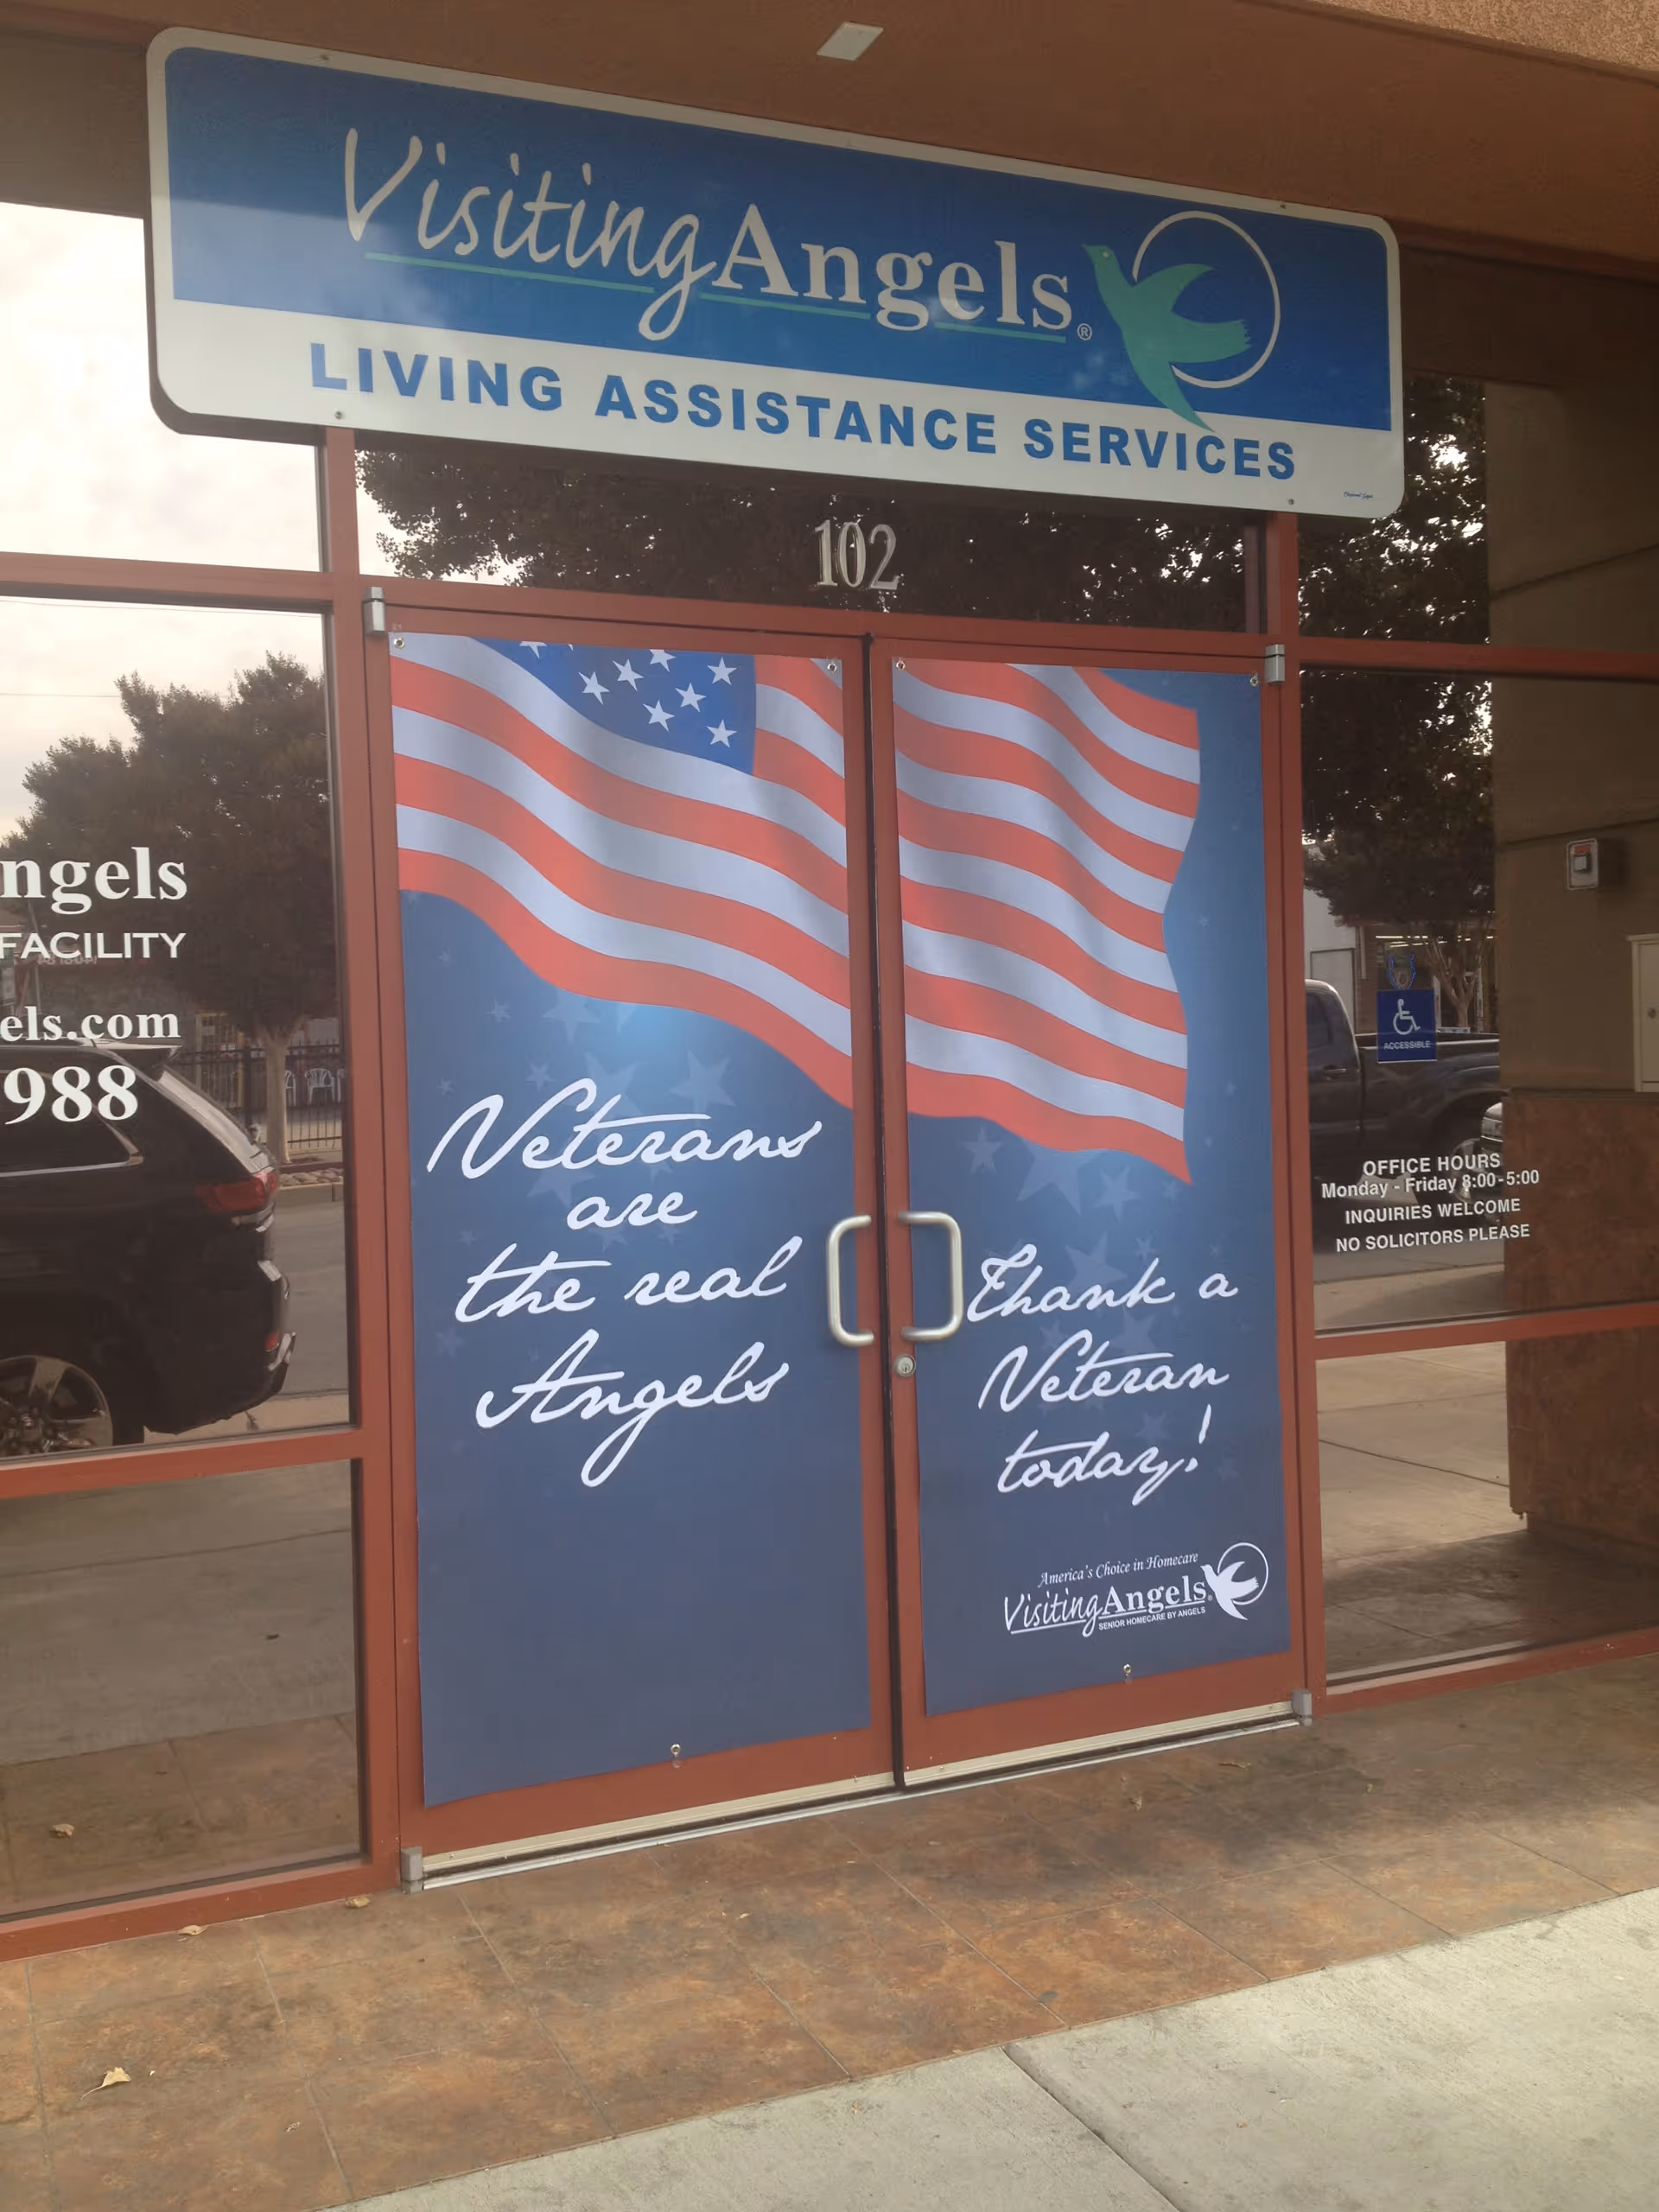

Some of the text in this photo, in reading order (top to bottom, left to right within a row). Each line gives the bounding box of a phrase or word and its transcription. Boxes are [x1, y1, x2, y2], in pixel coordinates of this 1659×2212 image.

[311, 342, 1296, 480] LIVING ASSISTANCE SERVICES
[814, 518, 899, 590] 102
[0, 931, 187, 958] FACILITY
[0, 1006, 181, 1041] els.com
[1383, 1040, 1431, 1050] ACCESSIBLE
[3, 1065, 138, 1125] 988
[427, 1077, 823, 1179] Veterans
[1363, 1153, 1501, 1176] OFFICE HOURS
[1321, 1179, 1389, 1199] Monday
[1405, 1176, 1457, 1194] Friday
[567, 1192, 698, 1230] are
[1345, 1198, 1521, 1224] INQUIRIES WELCOME
[1337, 1224, 1530, 1253] NO SOLICITORS PLEASE
[454, 1236, 803, 1323] the real
[967, 1243, 1238, 1322] Thank a
[977, 1329, 1230, 1412] Veteran
[475, 1328, 790, 1488] Angels
[997, 1404, 1211, 1506] today!
[1038, 1553, 1198, 1588] America's Choice in Homecare
[1098, 1606, 1206, 1630] SENIOR HOMECARE BY ANGELS
